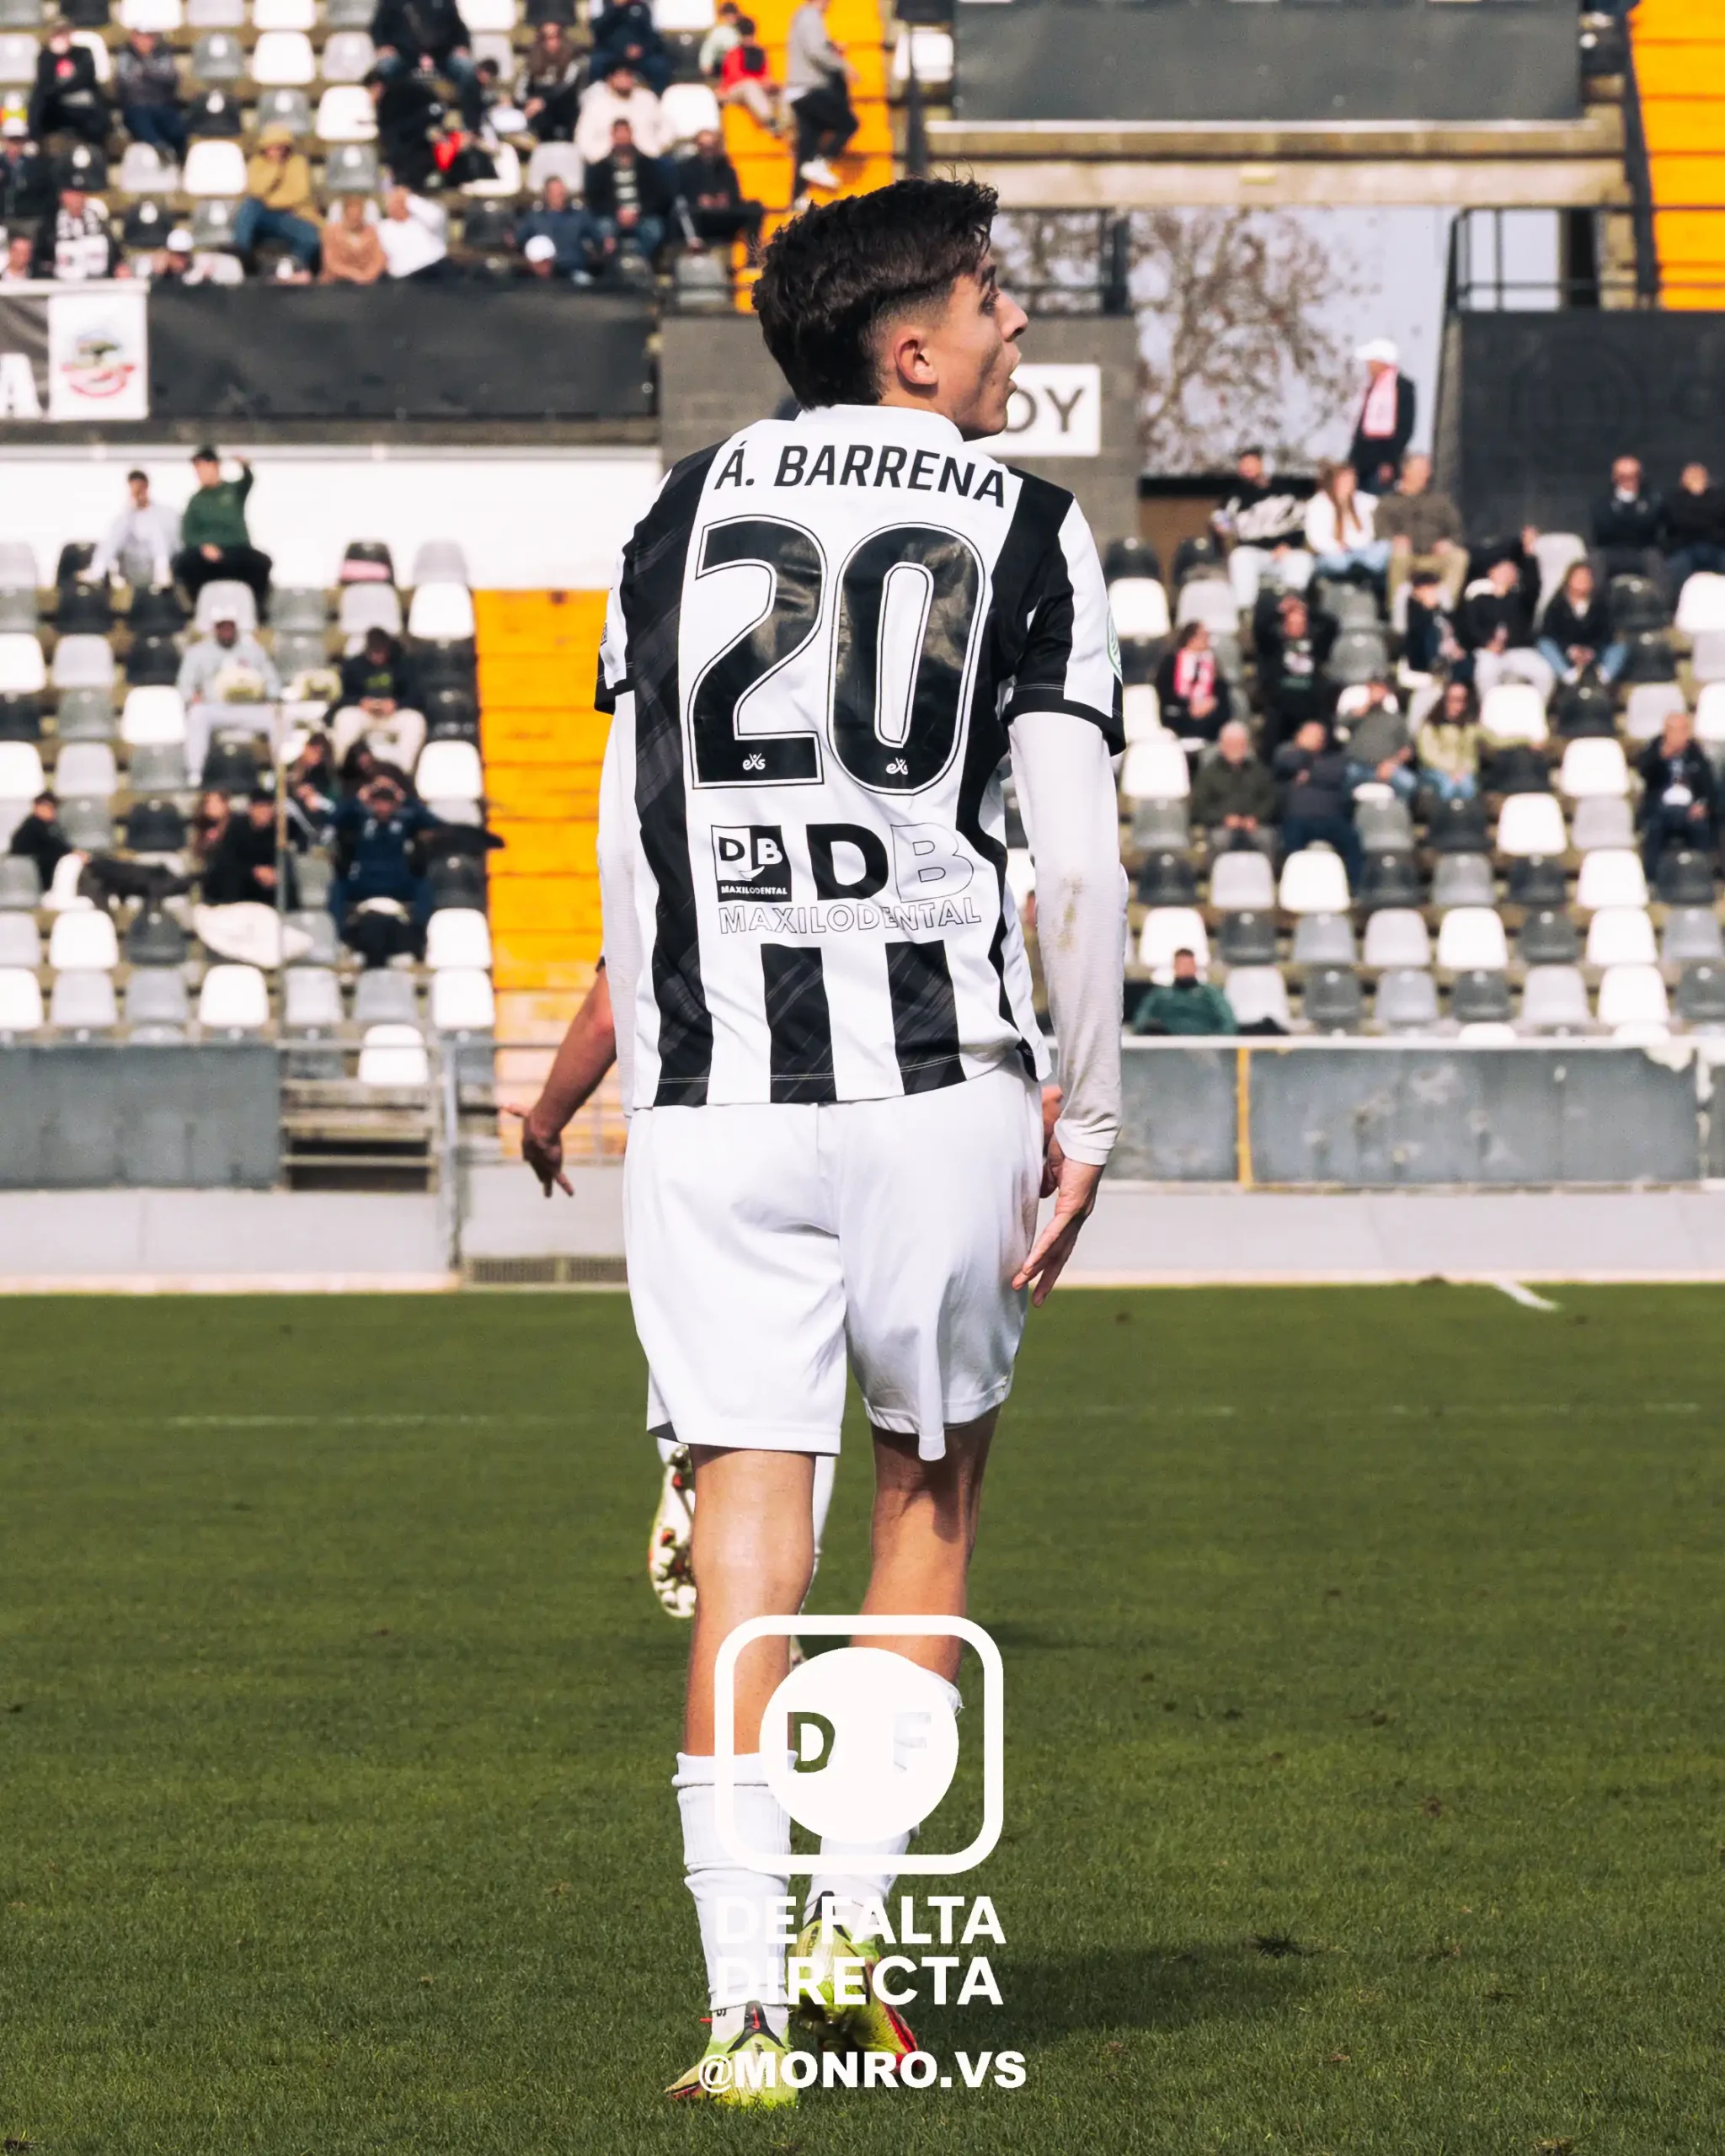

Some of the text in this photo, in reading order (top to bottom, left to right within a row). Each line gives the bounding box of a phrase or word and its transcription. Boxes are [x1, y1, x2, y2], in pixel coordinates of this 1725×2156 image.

[714, 440, 1005, 508] Á. BARRENA
[687, 514, 985, 796] 20
[718, 896, 982, 935] MAXILODENTAL
[720, 884, 788, 896] MAXILODENTAL
